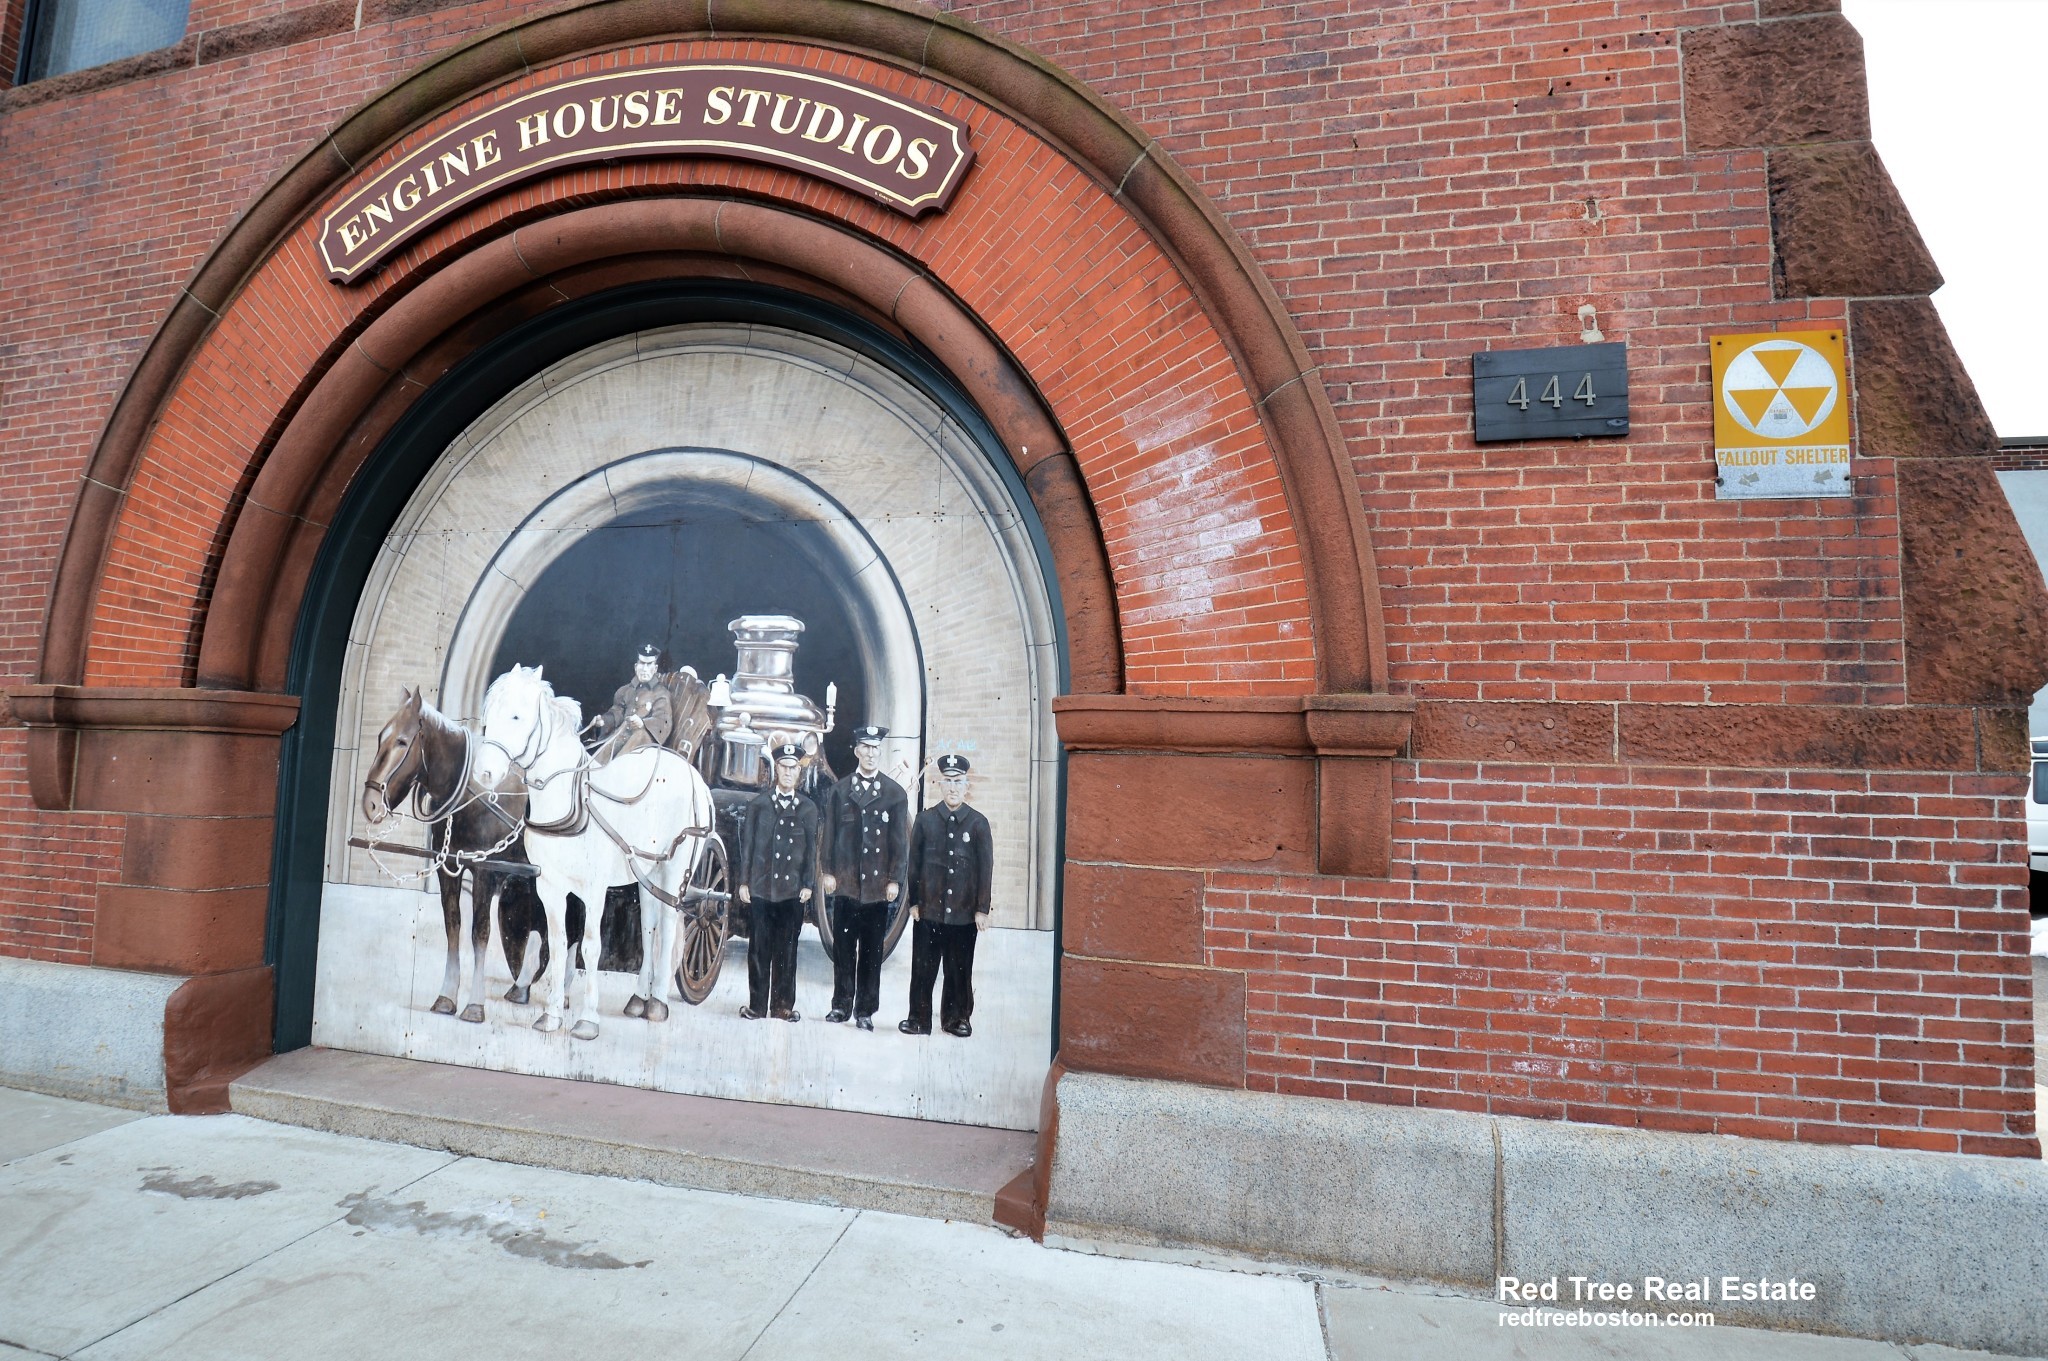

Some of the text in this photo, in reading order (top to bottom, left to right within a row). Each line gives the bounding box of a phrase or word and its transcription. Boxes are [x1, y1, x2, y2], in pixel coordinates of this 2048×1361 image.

[338, 86, 938, 256] ENGINE HOUSE STUDIOS
[1507, 373, 1596, 411] 444
[1717, 448, 1849, 466] FALLOUT SHELTER
